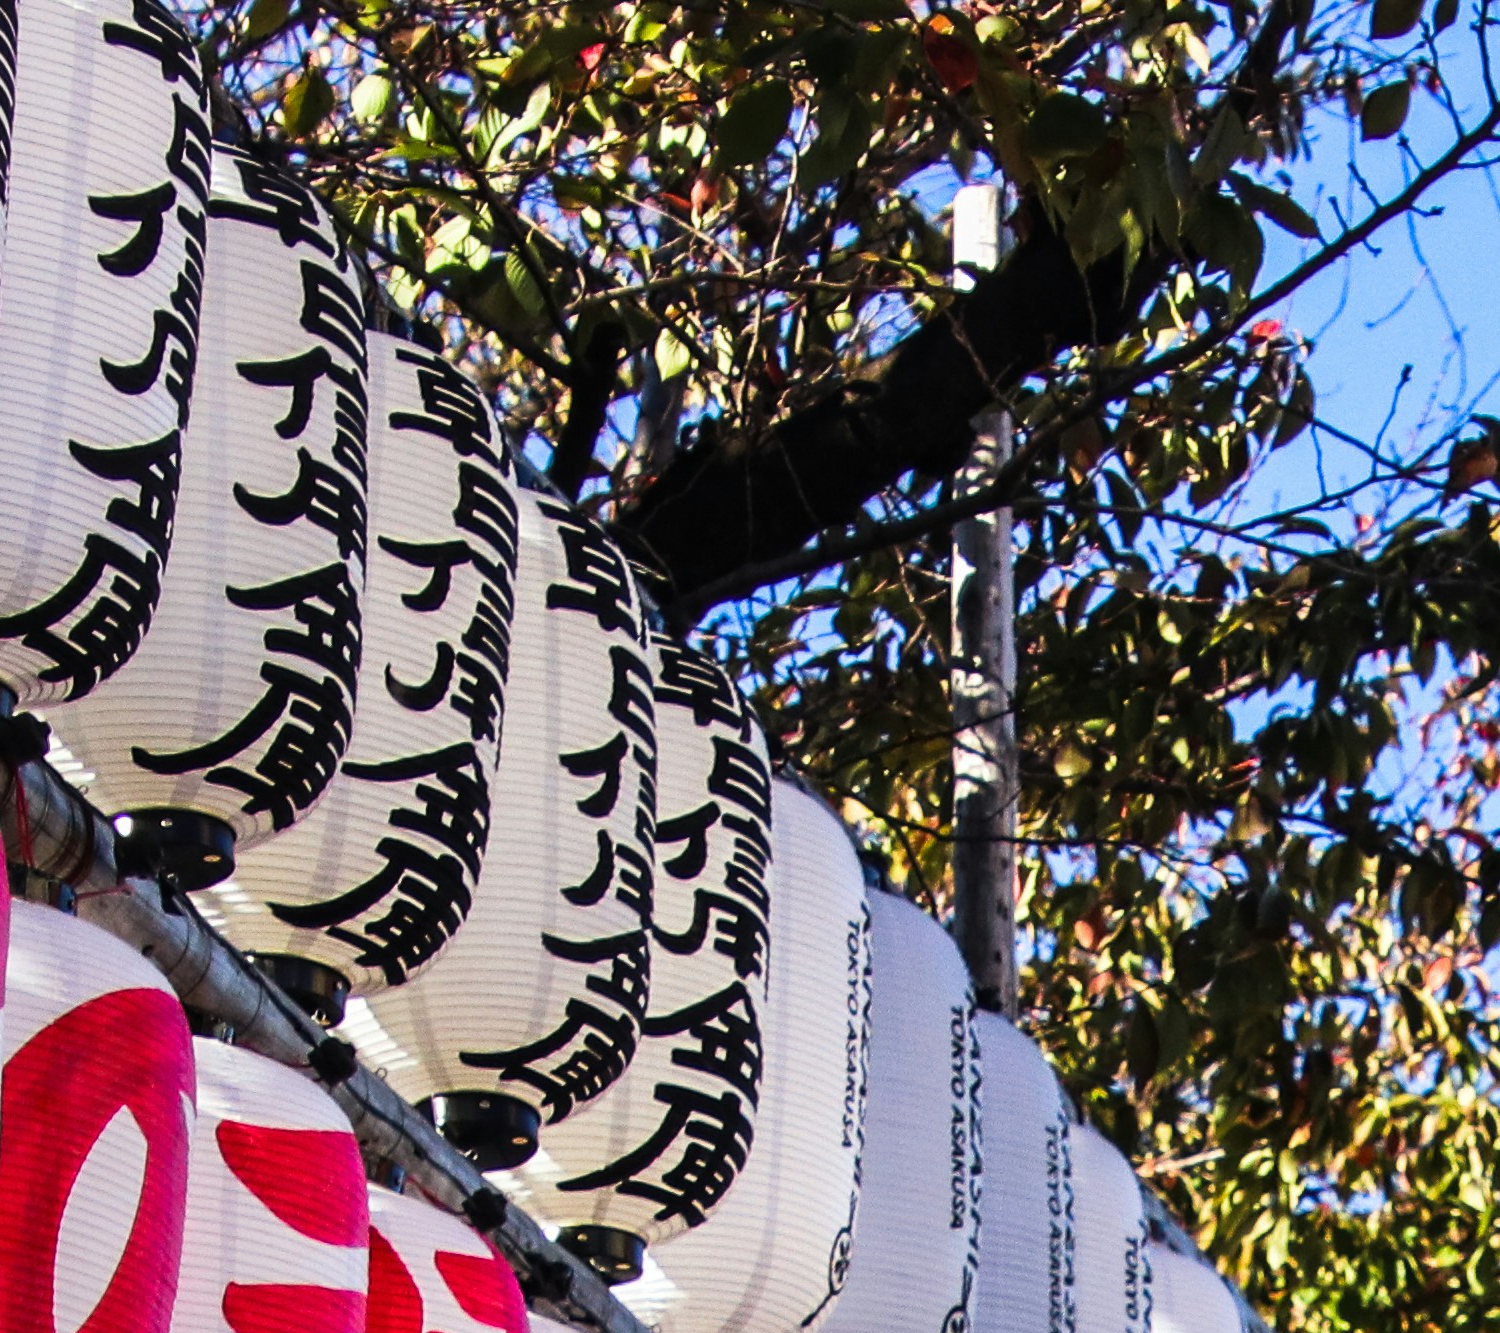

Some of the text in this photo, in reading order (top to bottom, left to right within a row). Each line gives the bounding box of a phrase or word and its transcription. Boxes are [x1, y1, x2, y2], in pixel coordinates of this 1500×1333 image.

[841, 919, 861, 1149] TOKYO ASAKUSA
[949, 1005, 967, 1231] TOKYO ASAKUSA
[1124, 1235, 1139, 1320] TOKYO
